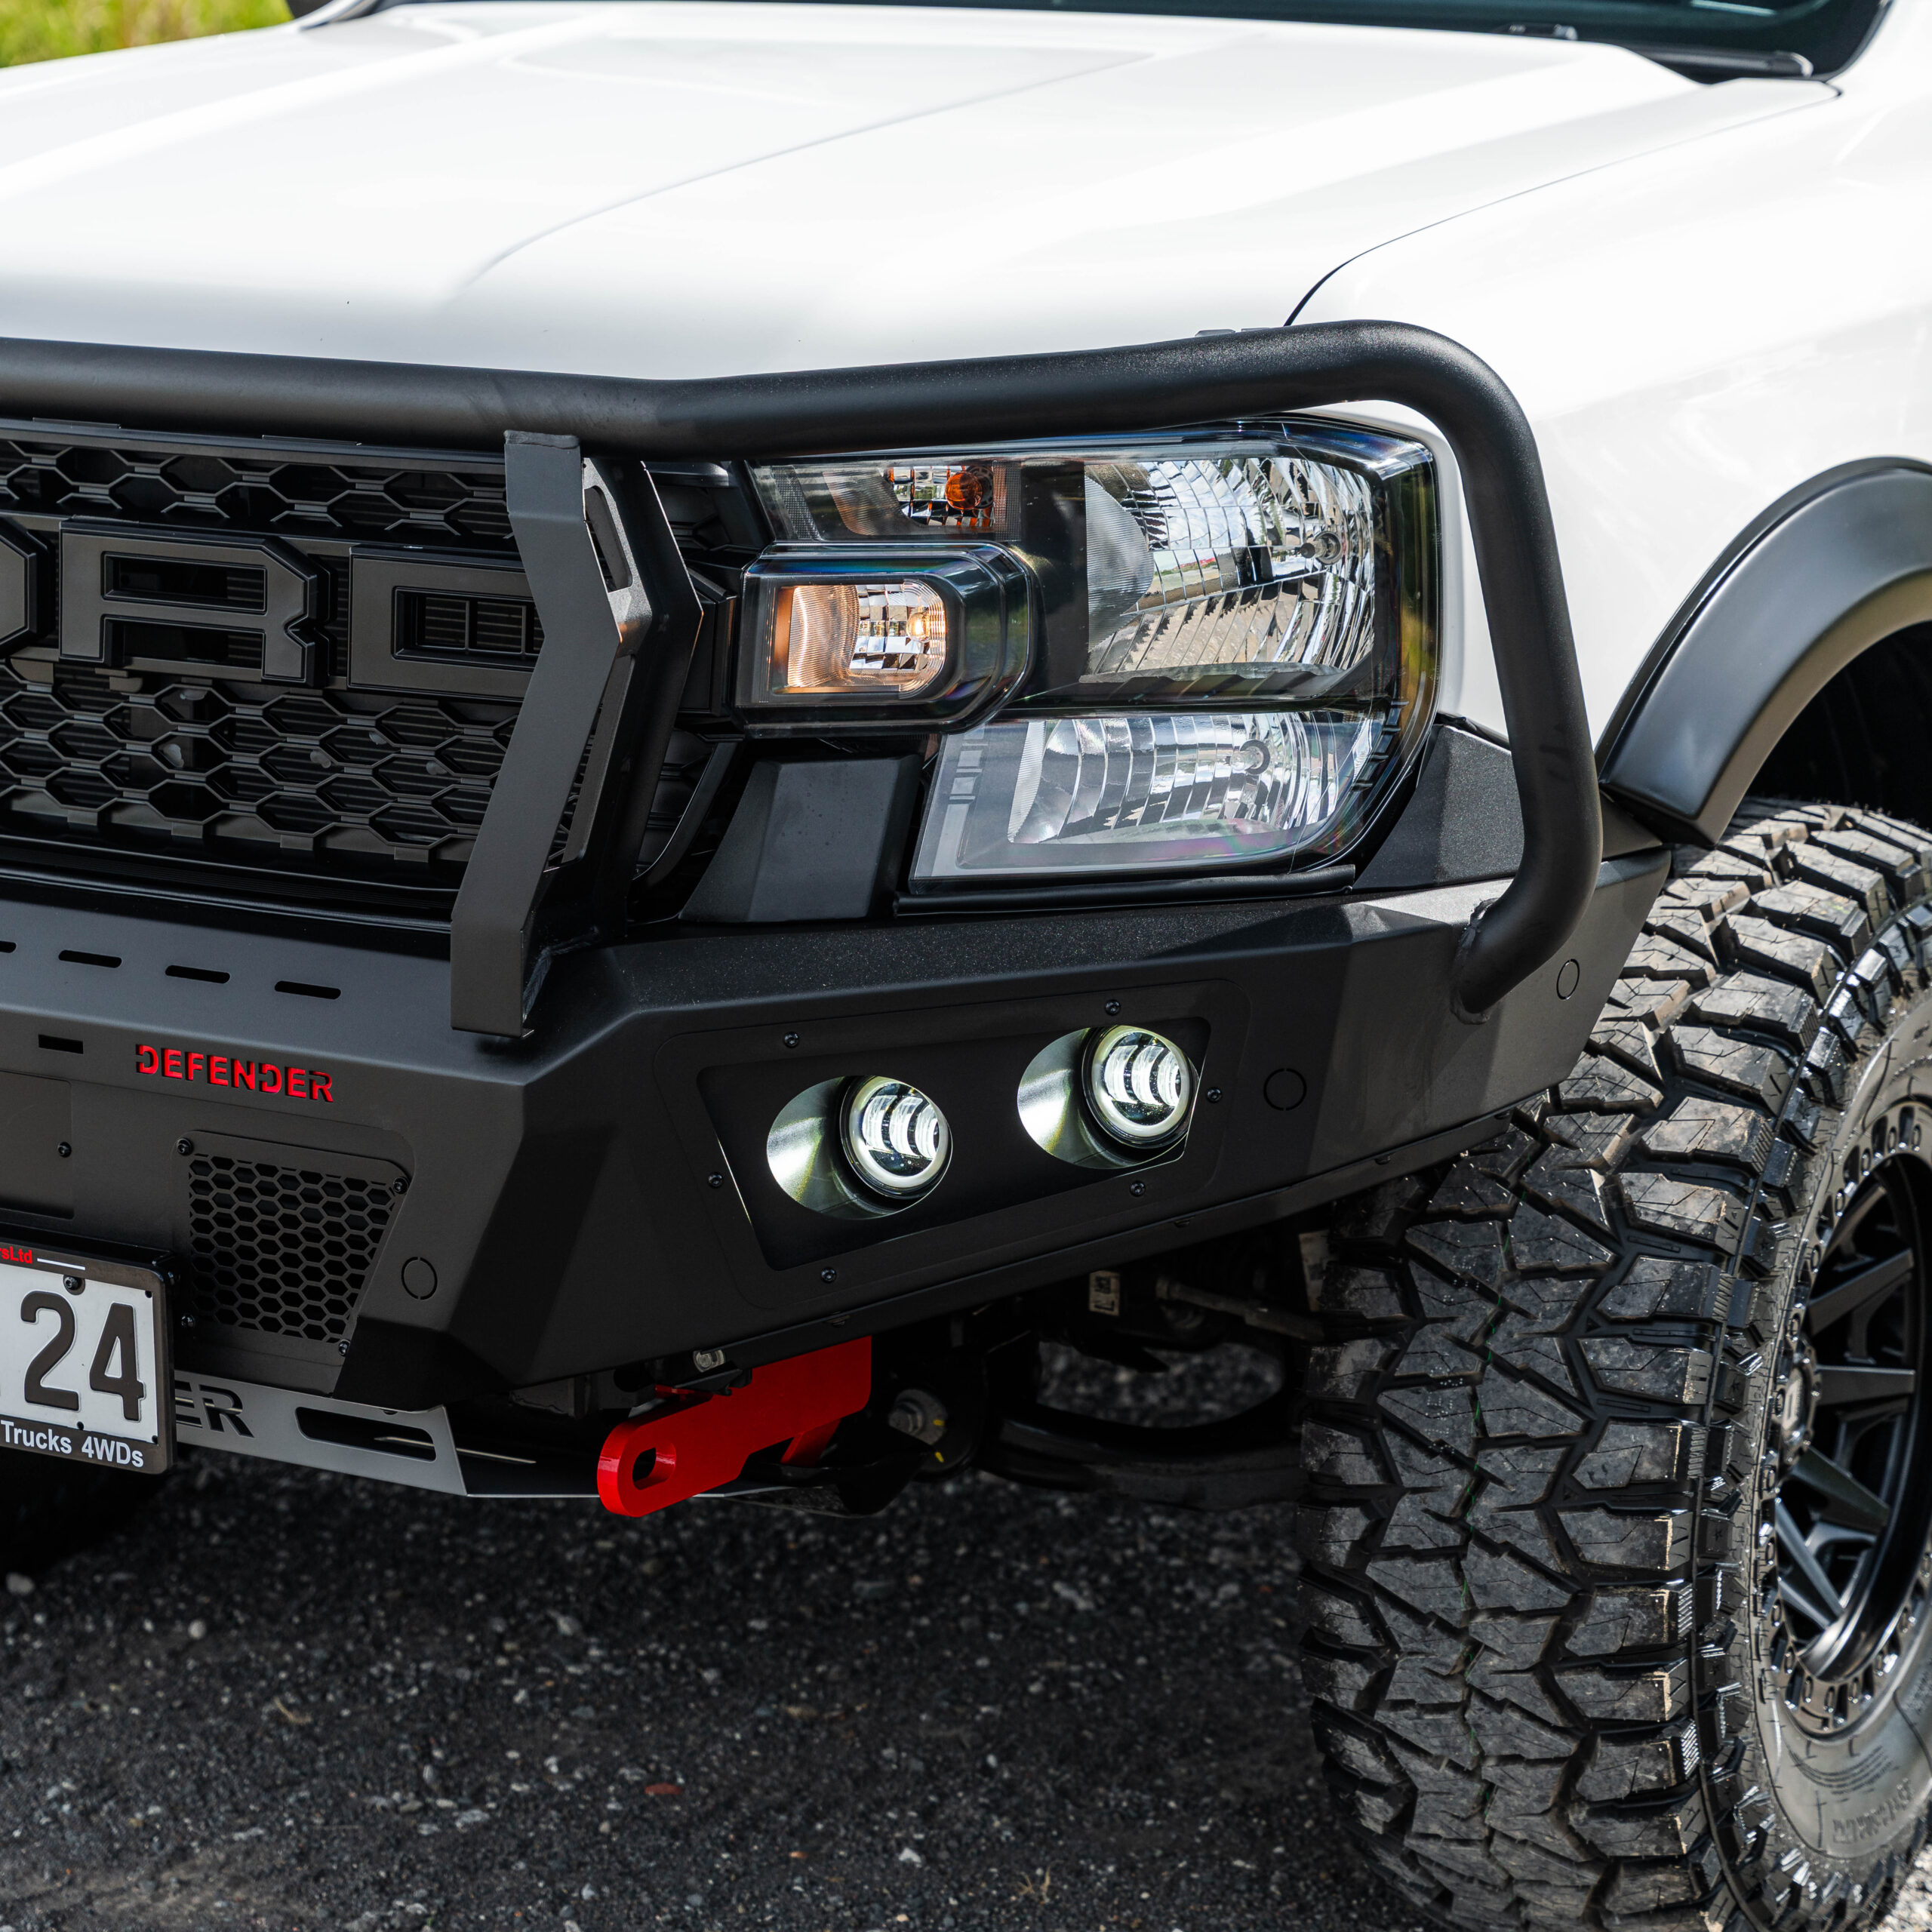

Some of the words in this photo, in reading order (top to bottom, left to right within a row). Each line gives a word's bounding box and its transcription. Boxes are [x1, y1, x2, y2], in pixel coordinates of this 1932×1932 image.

[136, 1044, 334, 1103] DEFENDER
[20, 1290, 146, 1422] 24
[1, 1420, 72, 1454] Trucks
[82, 1436, 143, 1467] 4WDs
